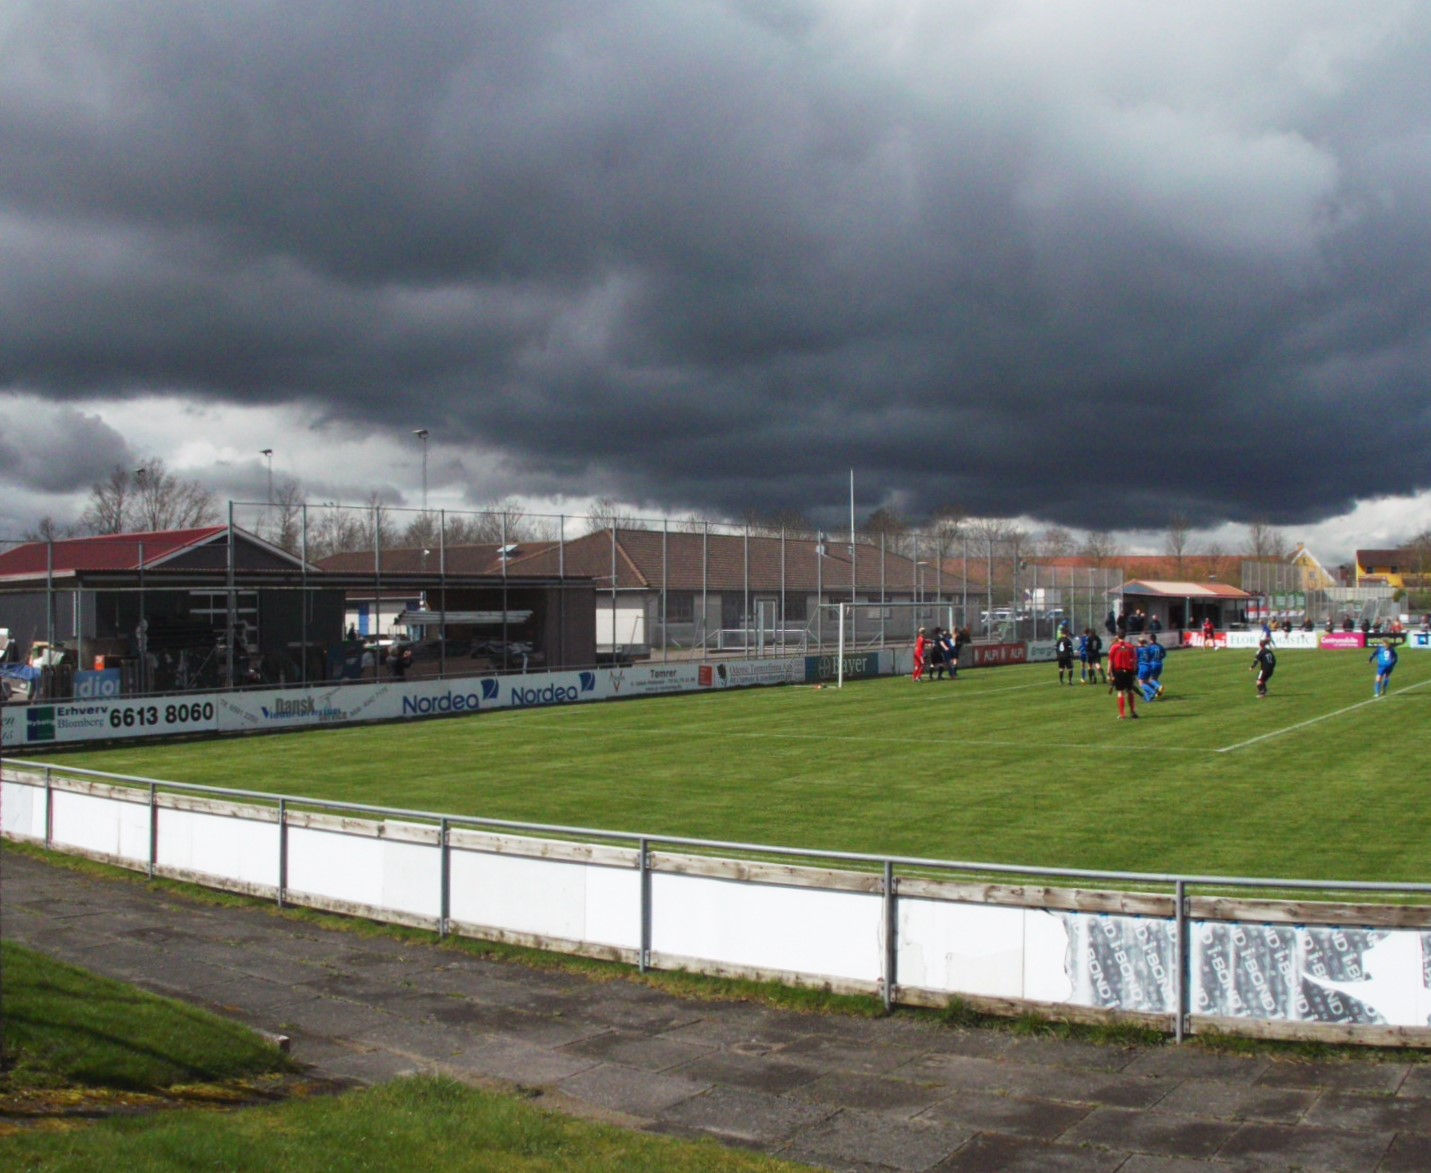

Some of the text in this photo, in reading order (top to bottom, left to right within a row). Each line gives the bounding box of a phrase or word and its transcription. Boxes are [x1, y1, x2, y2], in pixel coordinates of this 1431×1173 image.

[403, 692, 479, 714] Nordea
[511, 683, 578, 705] Nordea
[57, 702, 214, 728] Erhverv 6613 8060
[275, 697, 315, 714] Dansk
[57, 717, 104, 729] Blomberg
